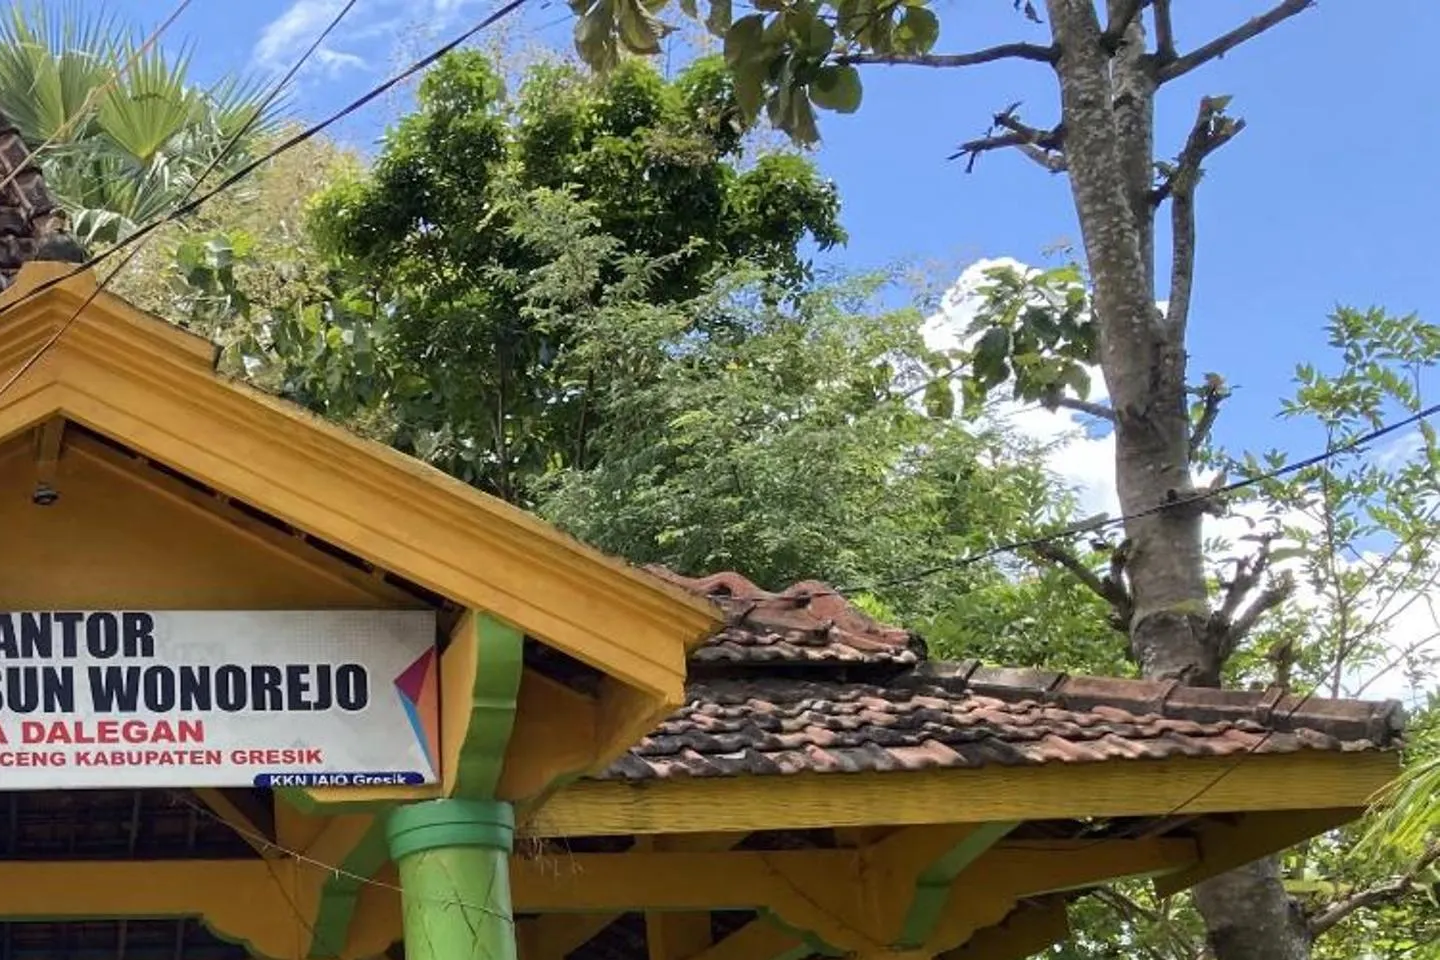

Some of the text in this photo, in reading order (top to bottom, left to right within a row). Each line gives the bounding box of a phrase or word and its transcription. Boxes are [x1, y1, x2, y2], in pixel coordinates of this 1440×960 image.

[87, 663, 369, 713] WONOREJO
[21, 718, 205, 745] DALEGAN
[75, 750, 222, 767] KABUPATEN
[230, 748, 324, 765] GRESIK
[269, 774, 308, 786] KKN
